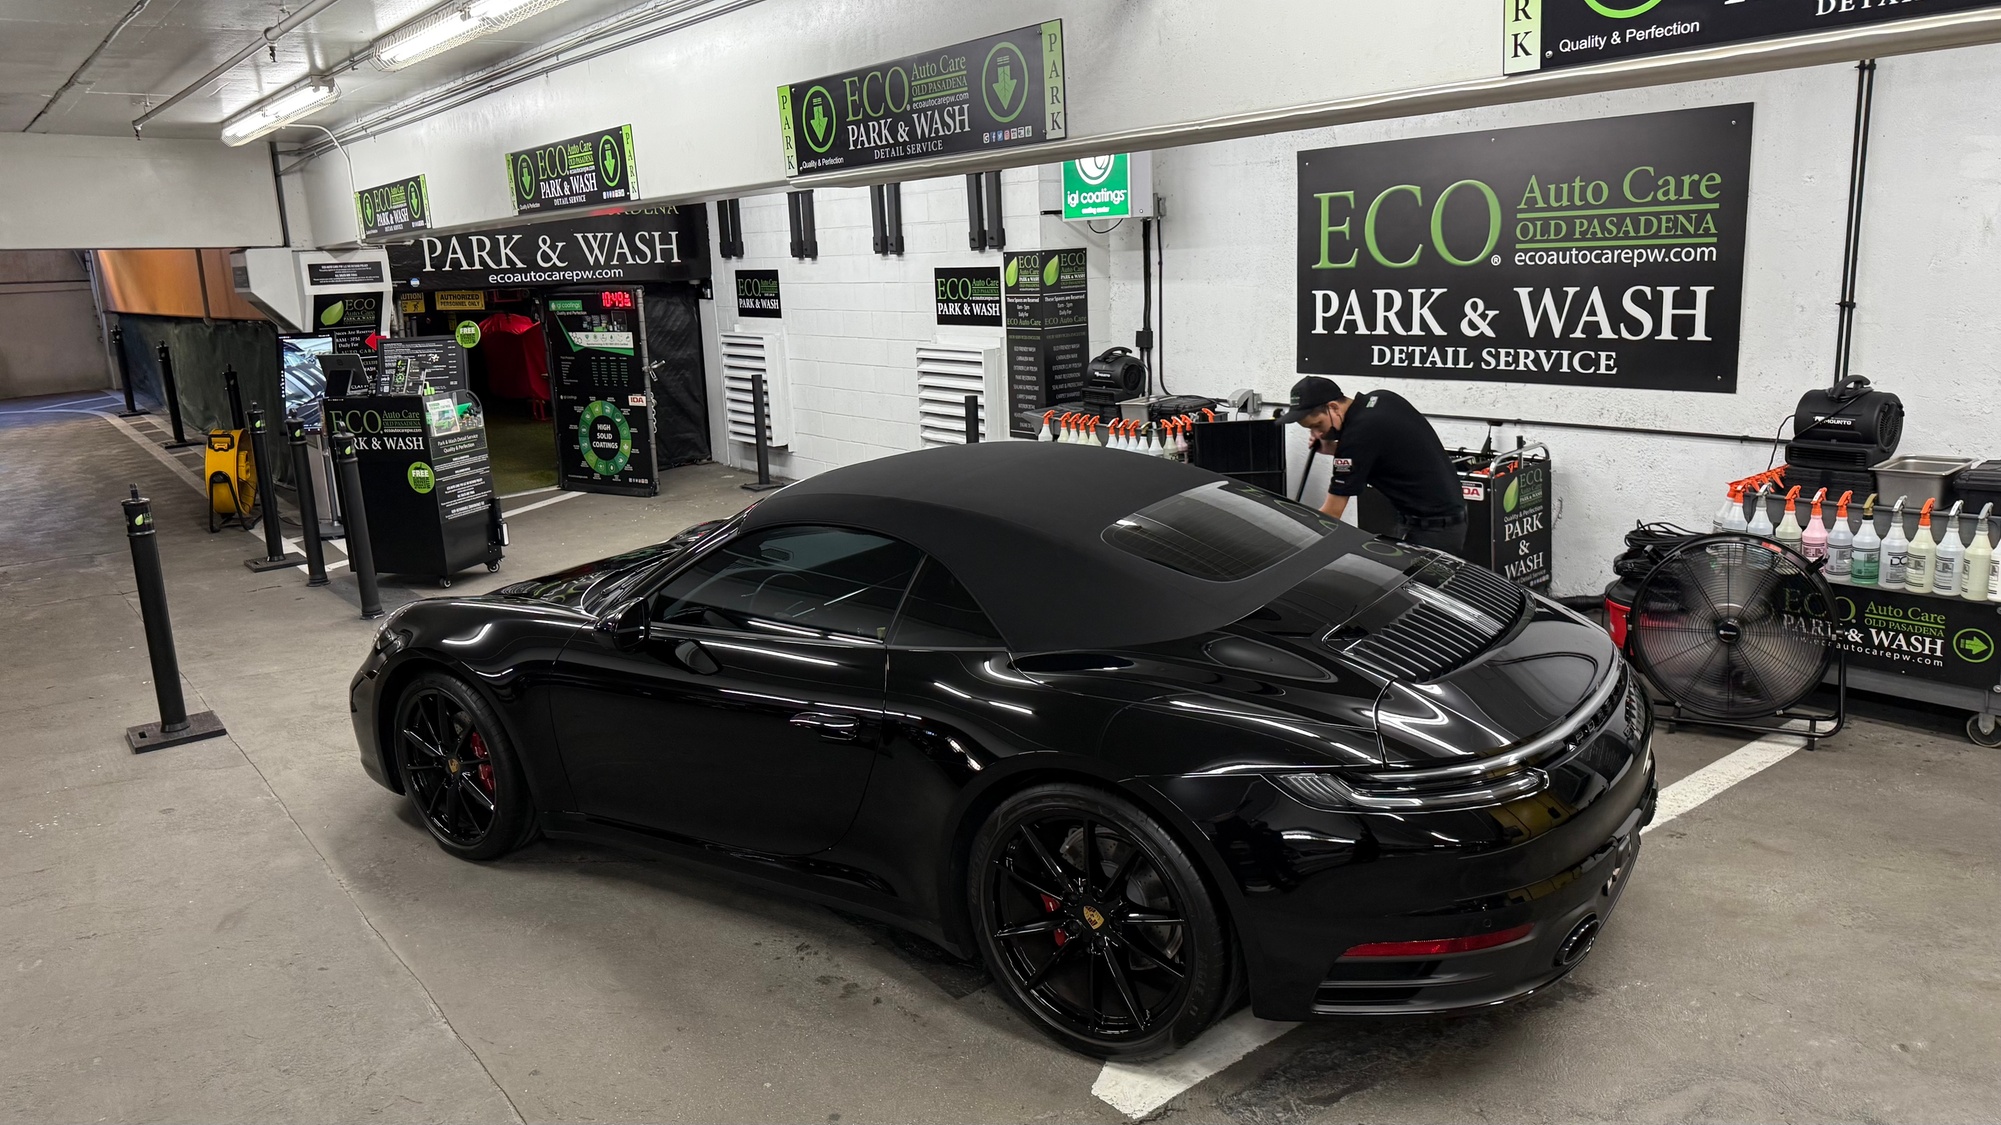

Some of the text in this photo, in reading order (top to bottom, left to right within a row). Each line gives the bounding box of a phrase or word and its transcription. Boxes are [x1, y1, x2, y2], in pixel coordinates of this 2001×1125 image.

[1559, 20, 1700, 52] Quality & Perfection
[911, 55, 966, 81] Auto Care
[912, 76, 968, 97] OLD PASADENA
[1048, 32, 1062, 131] PARK
[912, 92, 969, 110] ecoautocarepw.com
[781, 94, 794, 170] PARK
[847, 104, 971, 150] PARK & WASH
[568, 140, 592, 155] Auto Care
[874, 140, 944, 160] DETAIL SERVICE
[625, 132, 637, 194] PARK
[802, 160, 817, 170] Quality
[821, 156, 844, 167] Perfection
[540, 173, 598, 199] PARK & WASH
[1517, 166, 1722, 210] Auto Care
[554, 195, 586, 206] DETAIL SERVICE
[1067, 191, 1079, 208] igl
[377, 212, 390, 226] PARK
[393, 208, 409, 223] WASH
[1515, 212, 1718, 242] OLD PASADENA
[419, 231, 682, 272] PARK & WASH
[1060, 253, 1085, 266] ECO
[1514, 246, 1717, 267] ecoautocarepw.com
[1018, 255, 1039, 268] ECO
[488, 266, 623, 285] ecoautocarepw.com
[972, 278, 999, 286] Auto Care
[440, 293, 479, 301] AUTHORIZED
[737, 279, 760, 296] ECO
[937, 278, 971, 300] ECO
[345, 298, 376, 311] ECO
[602, 291, 624, 307] 10:49
[739, 299, 779, 309] PARK & WASH
[938, 303, 1000, 316] PARK & WASH
[1311, 285, 1715, 342] PARK & WASH
[1371, 345, 1617, 375] DETAIL SERVICE
[383, 409, 420, 419] Auto Care
[597, 423, 611, 431] HIGH
[371, 437, 382, 450] &
[383, 437, 425, 450] WASH
[592, 441, 619, 449] COATINGS
[412, 470, 429, 478] FREE
[1520, 468, 1542, 487] ECO
[1504, 513, 1518, 522] Quality
[1523, 505, 1543, 517] Perfection
[1505, 512, 1543, 541] PARK
[1519, 540, 1530, 555] &
[1504, 552, 1543, 580] WASH
[1865, 601, 1946, 624] Auto Care
[1864, 617, 1945, 637] OLD PASADENA
[1847, 628, 1864, 643] &
[1869, 628, 1945, 658] WASH
